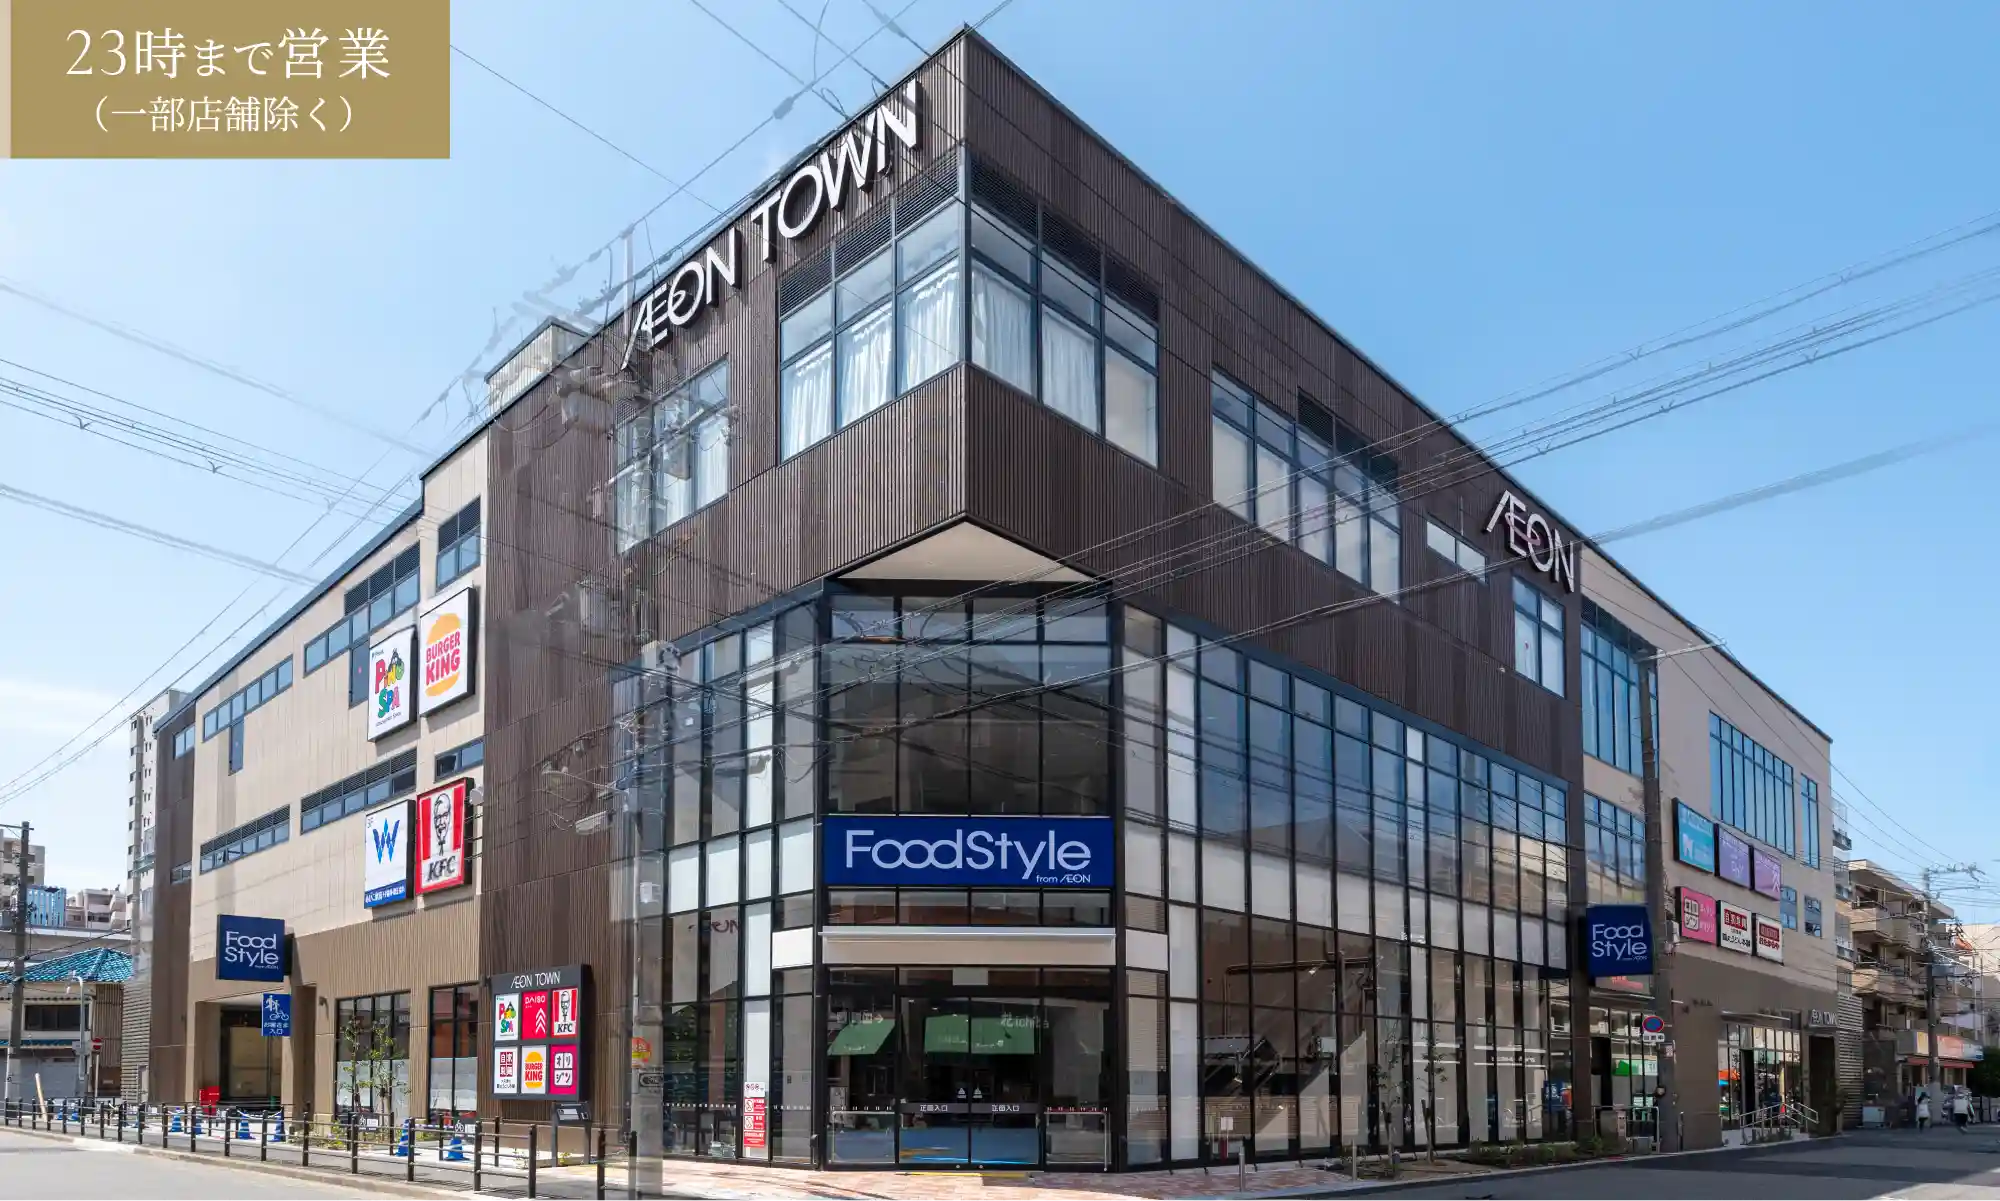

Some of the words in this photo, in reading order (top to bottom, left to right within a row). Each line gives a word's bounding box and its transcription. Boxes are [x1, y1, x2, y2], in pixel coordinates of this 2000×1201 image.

[751, 78, 919, 263] TOWN
[426, 631, 460, 663] BURGER
[426, 649, 460, 686] KING
[428, 856, 456, 882] KFC
[1036, 874, 1058, 883] from
[226, 930, 277, 949] Food
[1592, 922, 1644, 941] Food
[224, 946, 279, 967] Style
[1592, 938, 1647, 961] Style
[535, 971, 561, 986] TOWN
[525, 995, 546, 1004] DAISO
[557, 1024, 573, 1033] KFC
[525, 1071, 543, 1081] KING
